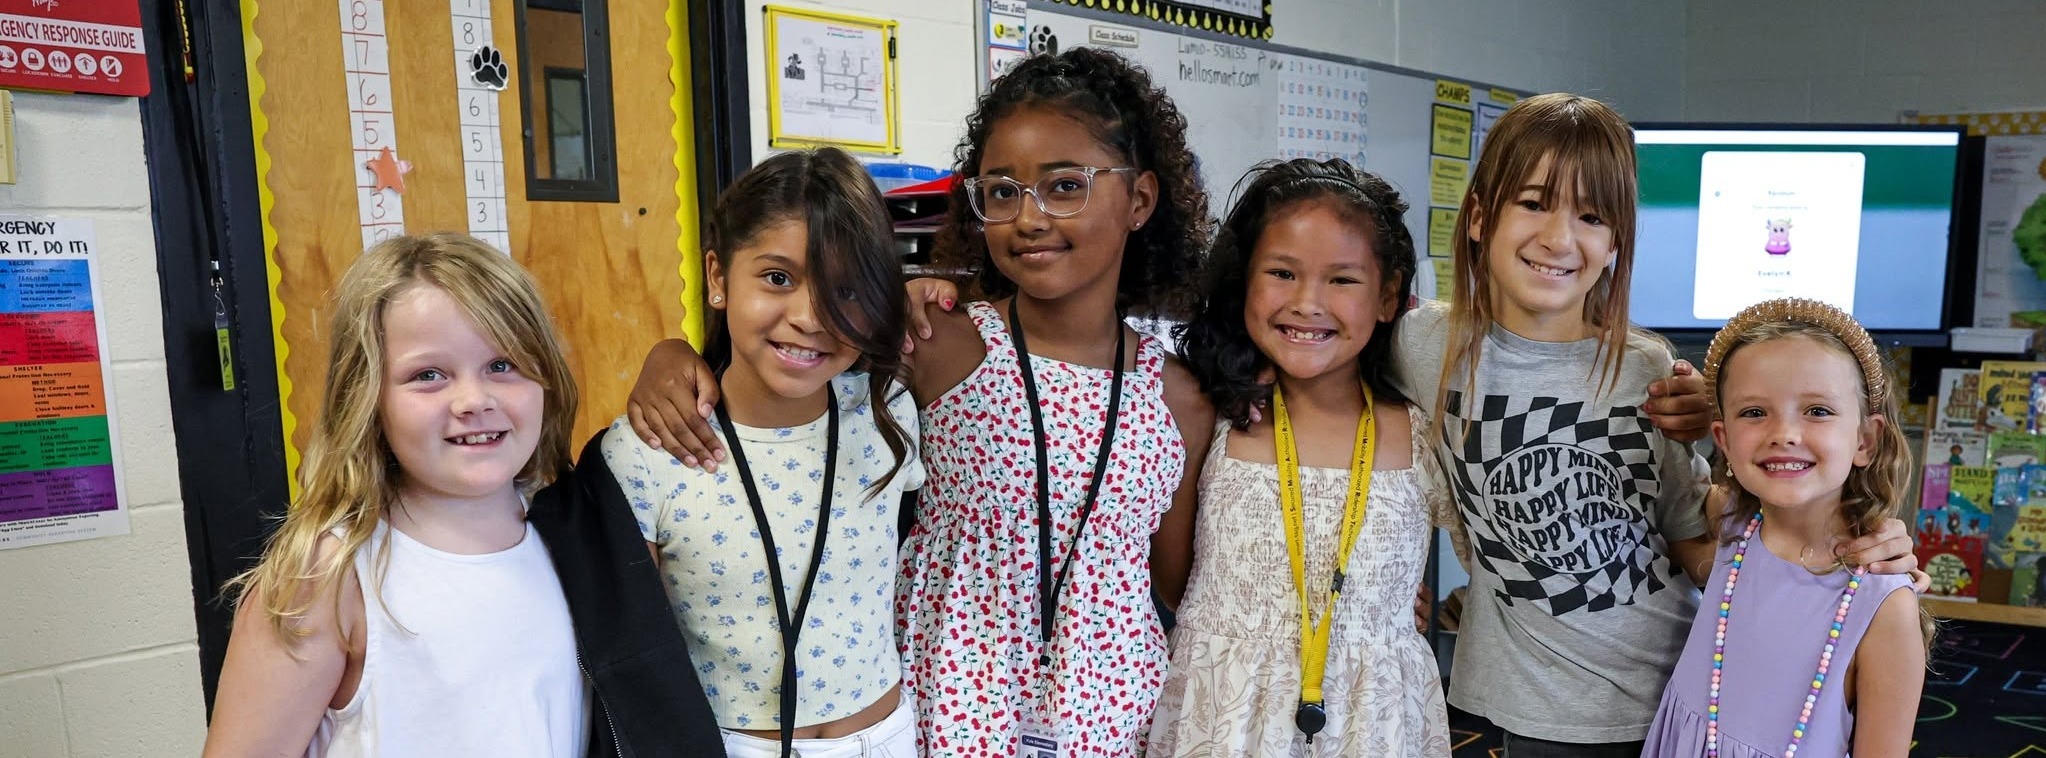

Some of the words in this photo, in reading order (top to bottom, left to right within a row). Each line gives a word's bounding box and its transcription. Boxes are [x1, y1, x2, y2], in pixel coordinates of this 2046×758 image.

[352, 1, 367, 30] 8
[0, 19, 39, 39] GENCY
[43, 23, 100, 46] RESPONSE
[102, 30, 136, 48] GUIDE
[463, 22, 474, 44] 8
[355, 40, 368, 65] 7
[359, 78, 377, 105] 6
[1437, 84, 1470, 103] CHAMPS
[469, 96, 480, 117] 6
[364, 121, 379, 144] 5
[472, 132, 483, 152] 5
[475, 169, 486, 191] 4
[371, 192, 386, 219] 3
[477, 202, 487, 222] 3
[0, 240, 11, 254] R
[17, 240, 38, 255] IT,
[43, 240, 63, 254] DO
[69, 240, 89, 255] IT!
[1490, 447, 1563, 496] HAPPY
[1567, 449, 1620, 491] MIND
[1494, 477, 1570, 524] HAPPY
[1574, 472, 1620, 506] LIFE
[1493, 512, 1576, 552] HAPPY
[1575, 502, 1630, 528] MIND
